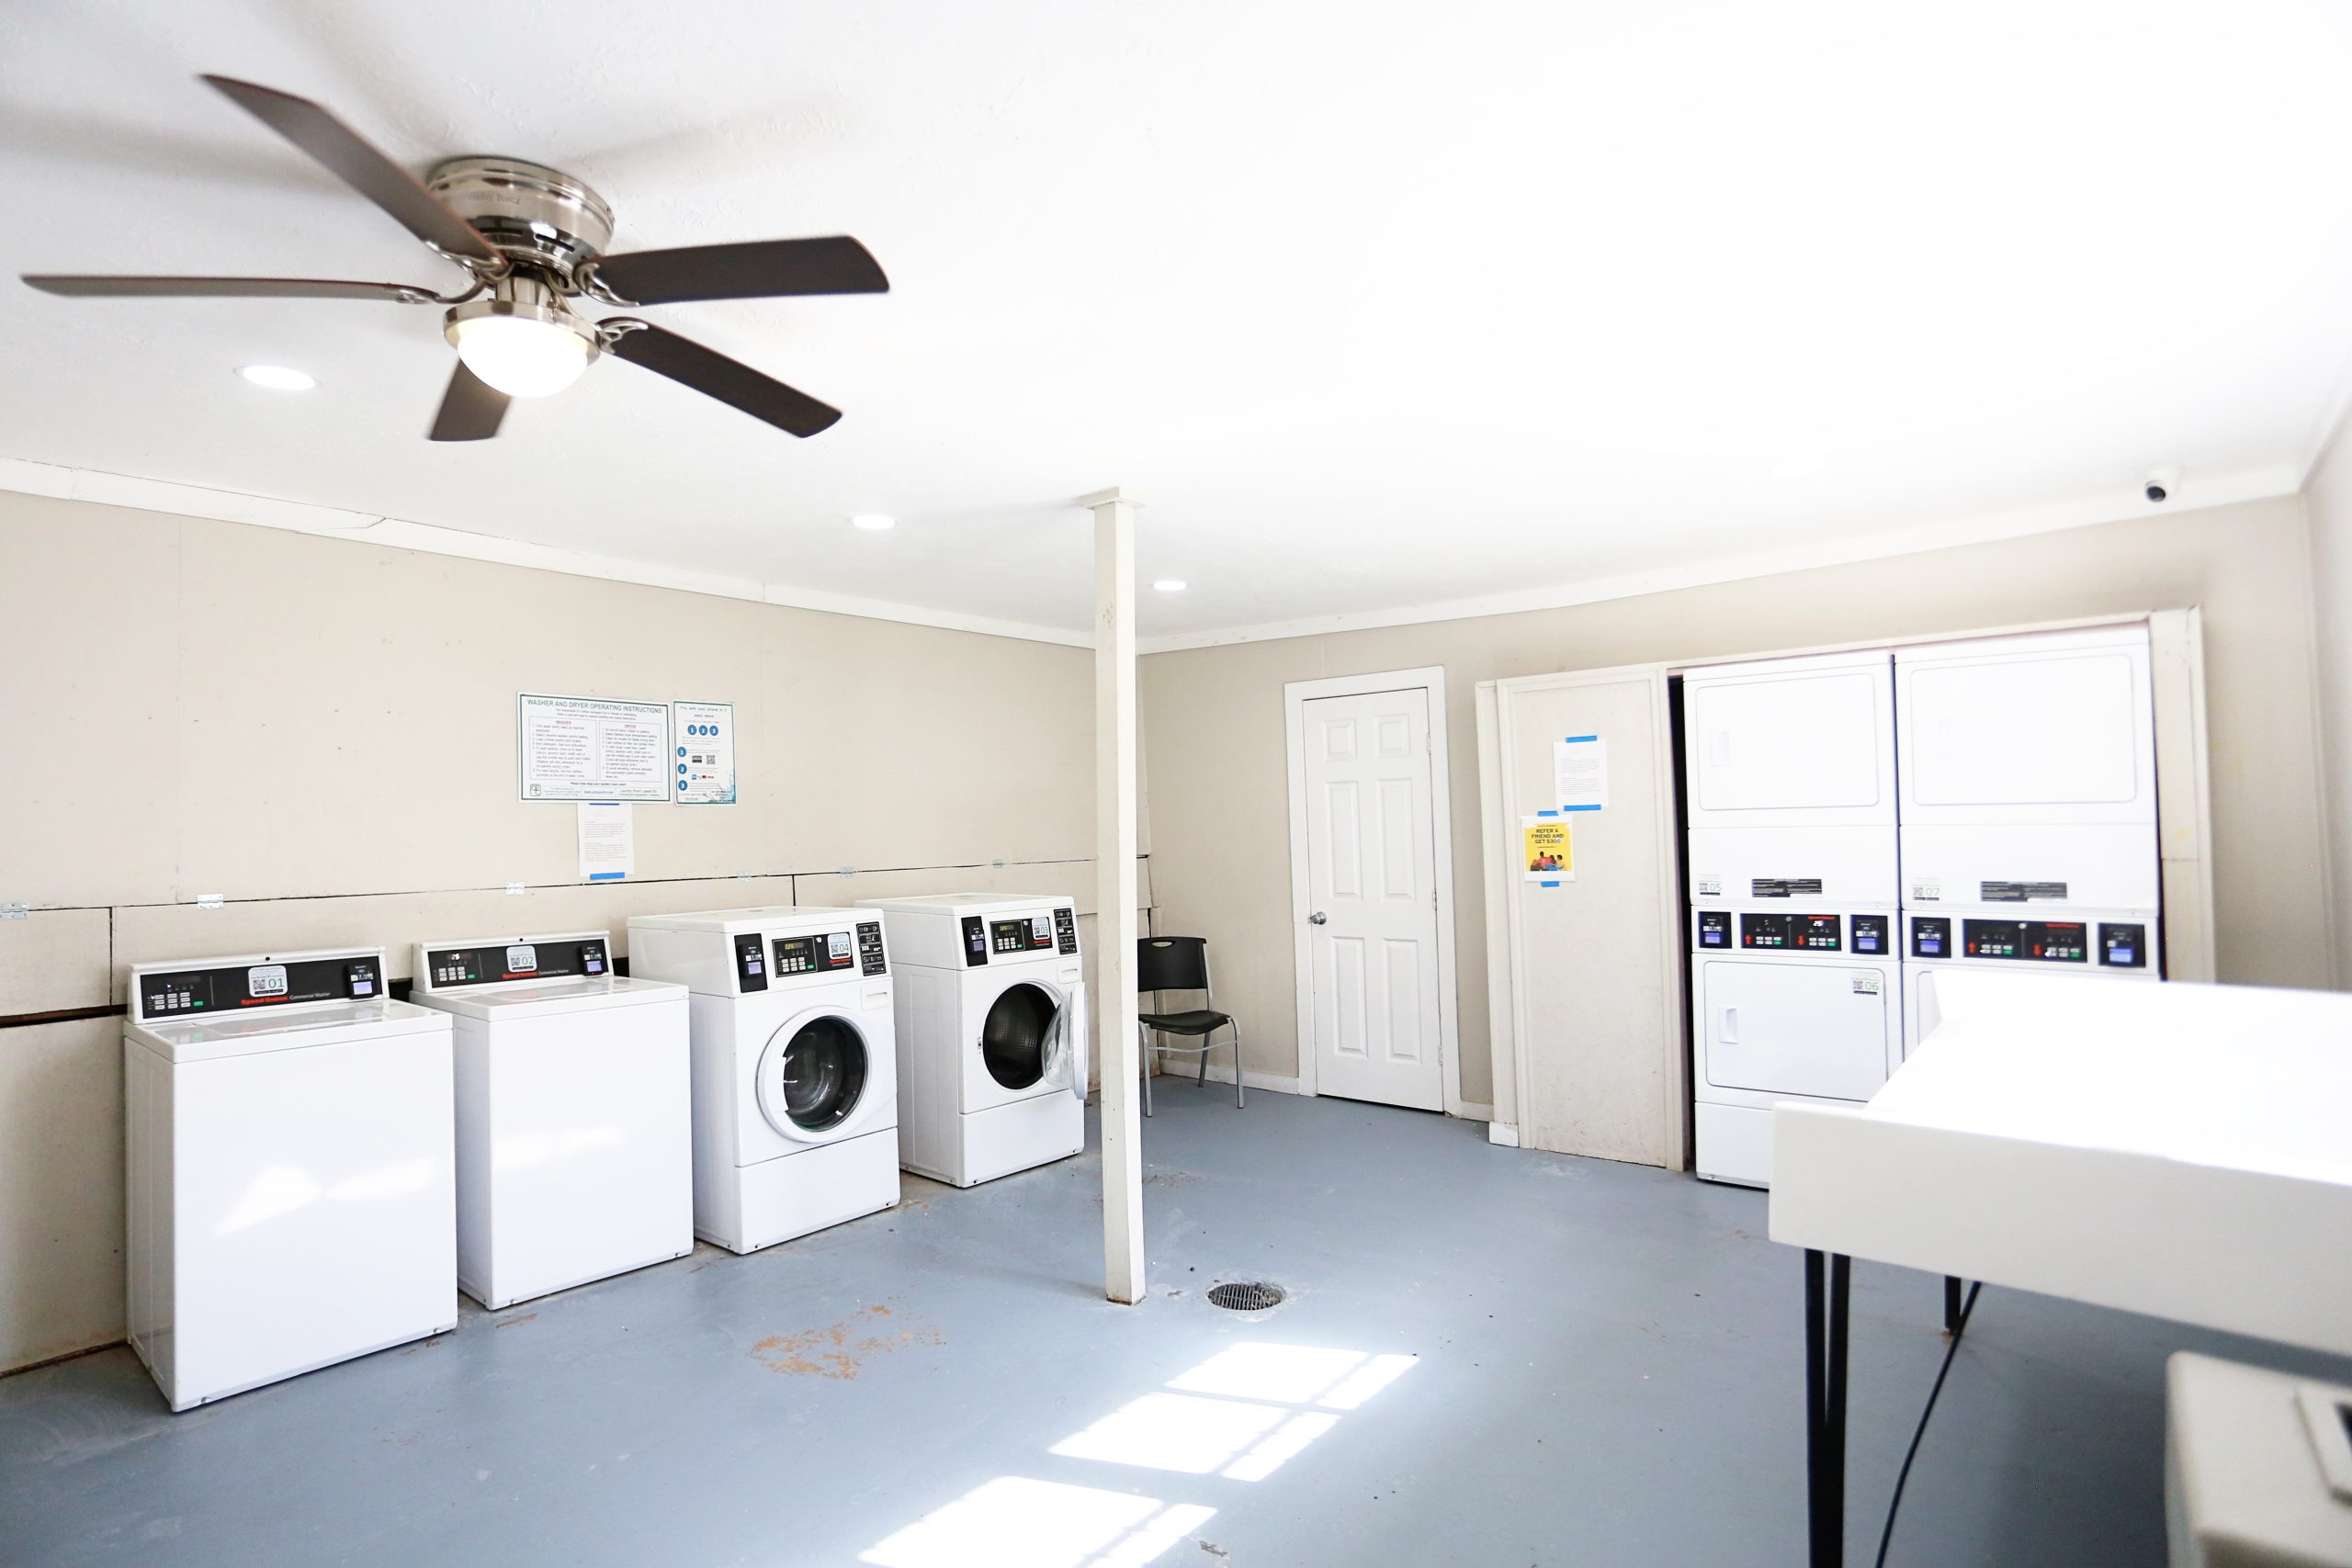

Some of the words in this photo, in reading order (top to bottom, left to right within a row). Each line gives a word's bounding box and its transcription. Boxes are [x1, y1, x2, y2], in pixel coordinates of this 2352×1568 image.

[623, 705, 662, 714] INSTRUCTIONS
[1709, 883, 1722, 891] 05
[1925, 887, 1939, 897] 07
[839, 943, 849, 953] 04
[521, 956, 534, 965] 02
[268, 978, 285, 988] 01
[1864, 982, 1879, 991] 06
